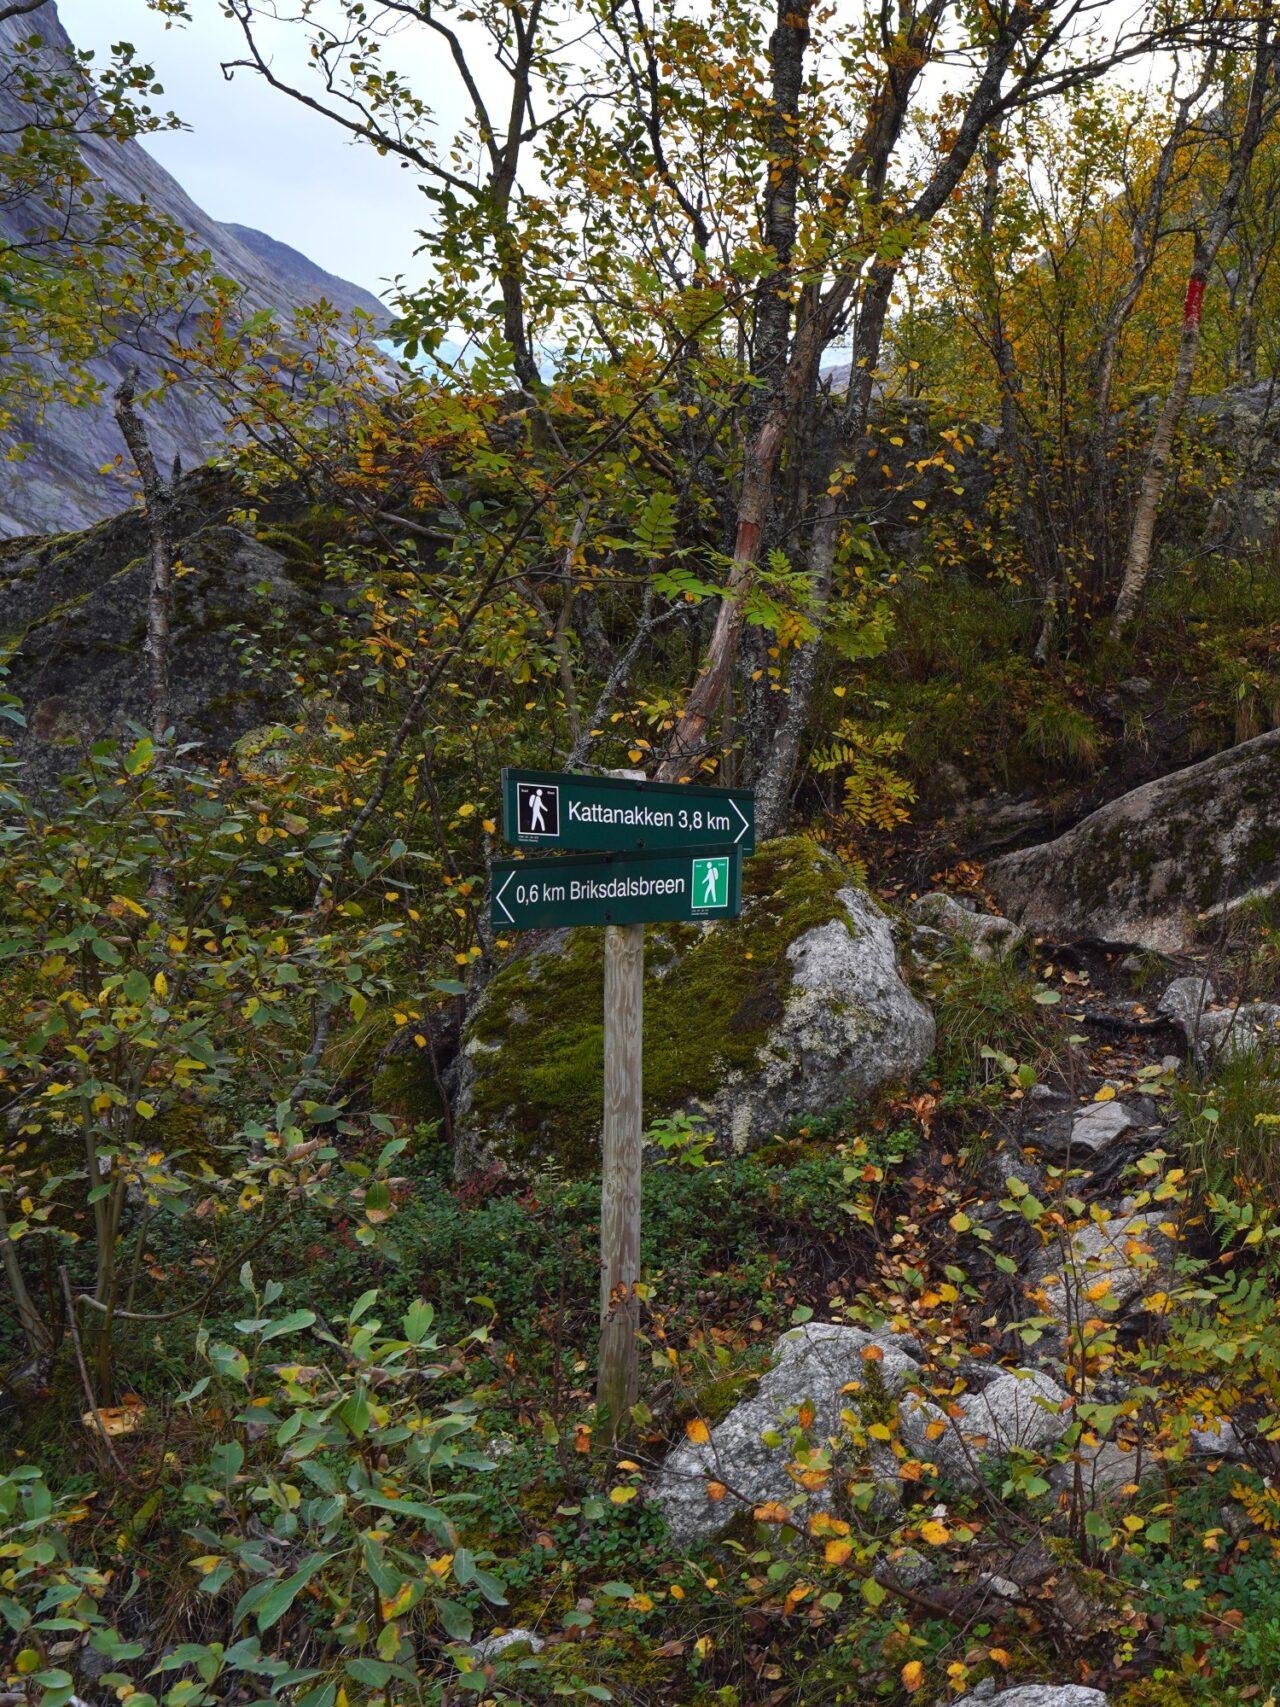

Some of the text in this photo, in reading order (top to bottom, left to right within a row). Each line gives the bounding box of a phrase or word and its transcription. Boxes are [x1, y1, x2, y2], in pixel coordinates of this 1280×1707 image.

[568, 800, 730, 831] Kattanakken 3,8 km
[516, 876, 685, 906] 0,6 km Briksdalsbreen
